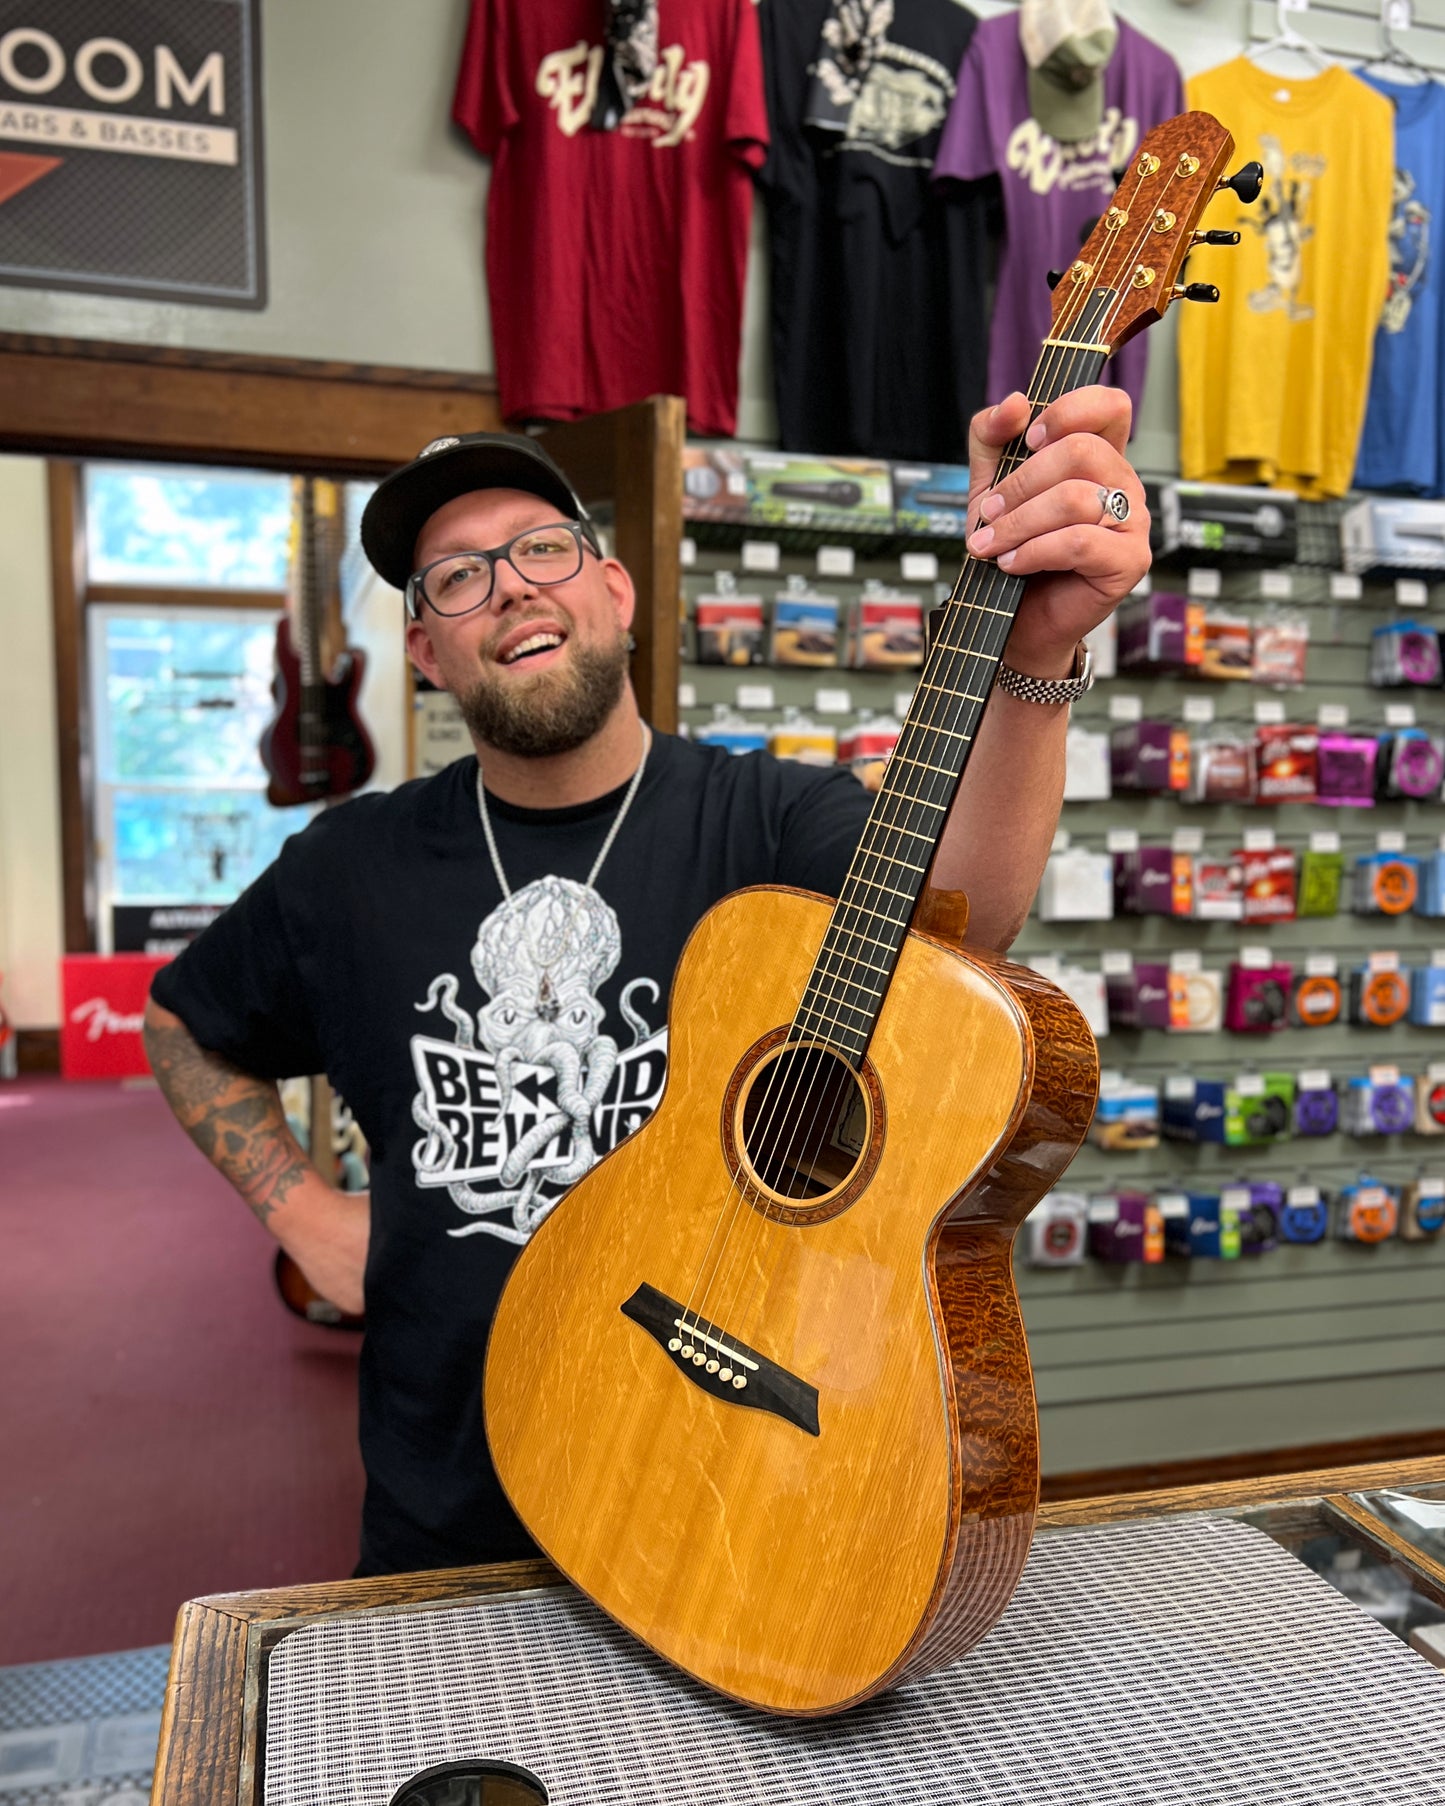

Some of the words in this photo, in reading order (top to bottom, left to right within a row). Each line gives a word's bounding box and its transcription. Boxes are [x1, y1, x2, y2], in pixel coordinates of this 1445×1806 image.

[70, 119, 87, 138] &
[100, 121, 210, 152] BASSES
[70, 997, 144, 1043] Fen
[423, 1051, 500, 1107] BE
